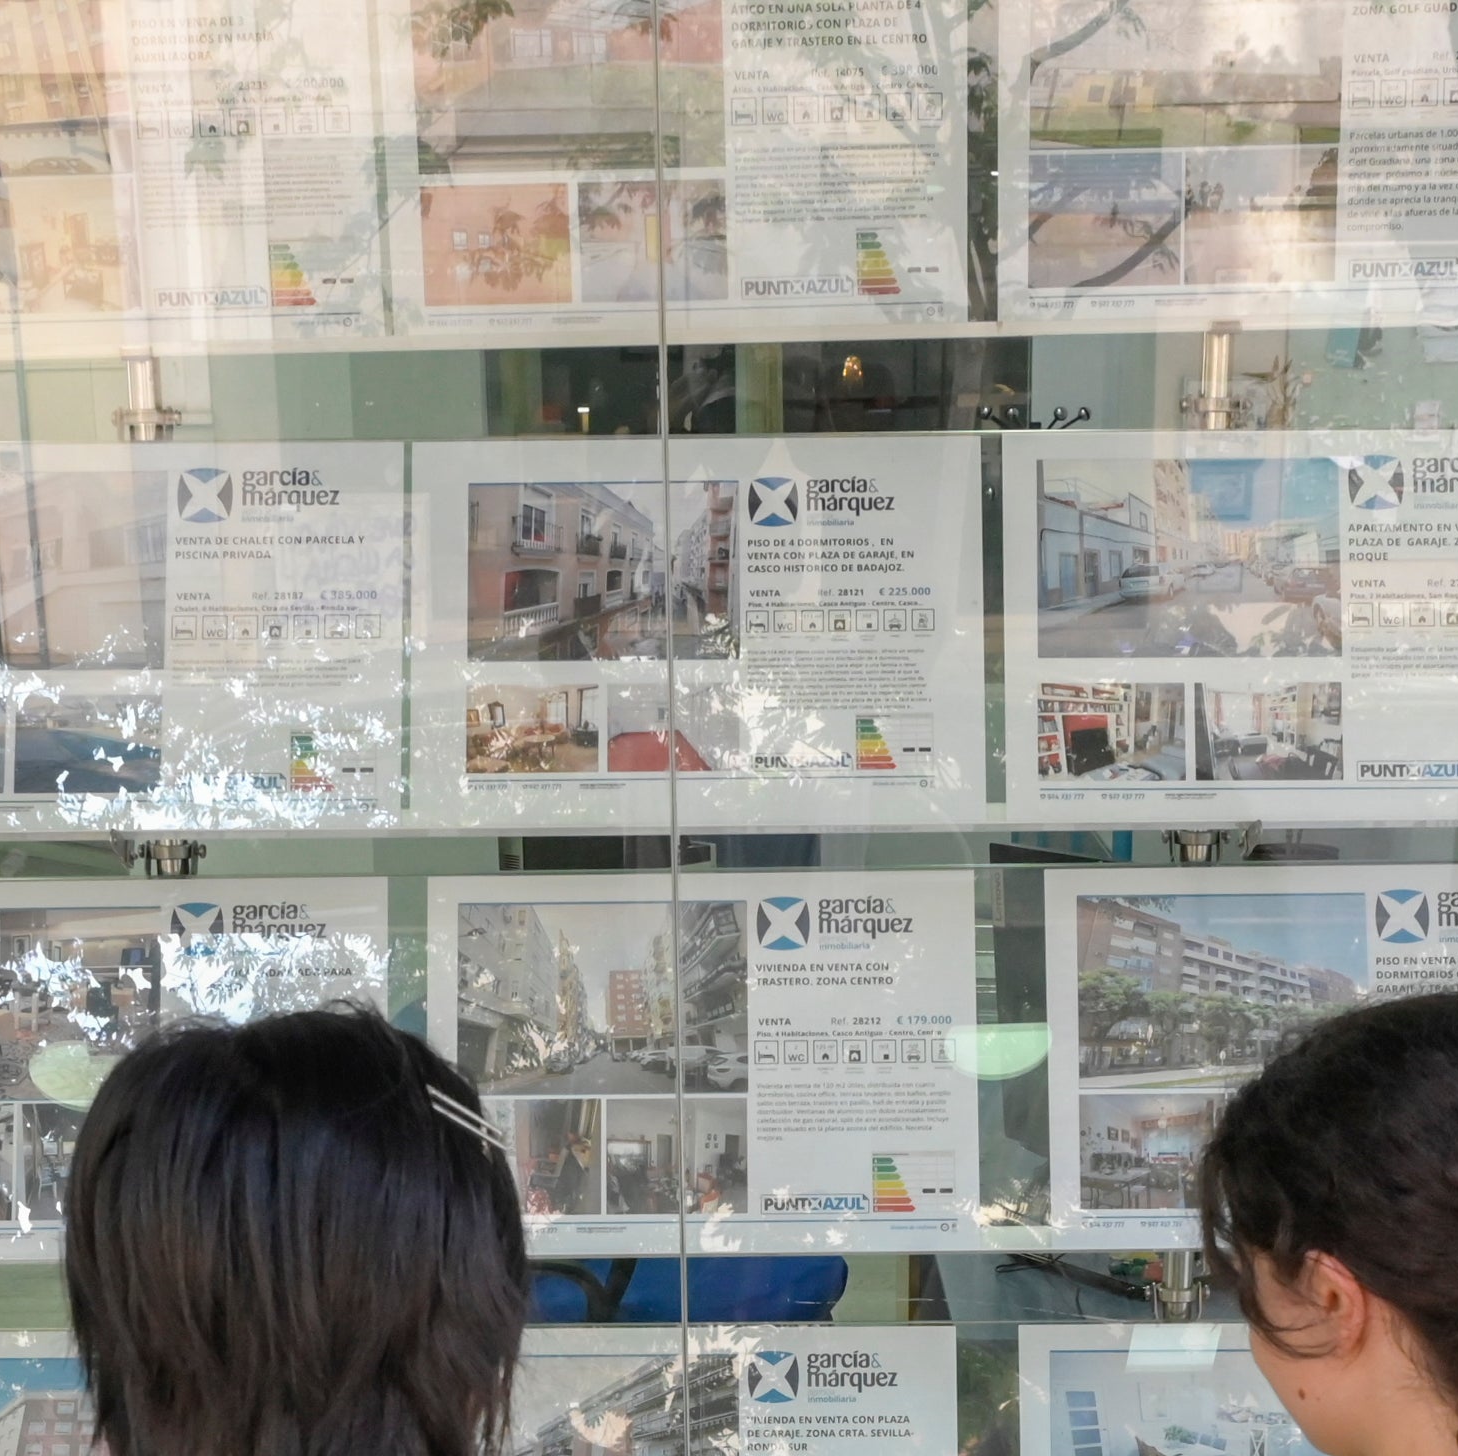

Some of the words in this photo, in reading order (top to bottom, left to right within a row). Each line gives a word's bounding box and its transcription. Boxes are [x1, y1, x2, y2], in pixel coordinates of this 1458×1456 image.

[1351, 5, 1384, 16] ZONA
[1389, 4, 1422, 15] GOLF
[787, 37, 843, 46] TRASTERO
[848, 36, 861, 45] EN
[866, 35, 877, 44] EL
[882, 34, 927, 44] CENTRO
[1354, 53, 1390, 63] VENTA
[806, 495, 895, 517] márquez
[747, 538, 771, 548] PISO
[773, 538, 786, 548] DE
[788, 538, 795, 547] 4
[797, 538, 870, 547] DORMITORIOS
[880, 537, 894, 546] EN
[175, 551, 219, 559] PISCINA
[222, 550, 271, 559] PRIVADA
[747, 551, 781, 561] VENTA
[783, 551, 805, 560] CON
[808, 550, 841, 560] PLAZA
[842, 550, 855, 560] DE
[858, 550, 898, 561] GARAJE,
[901, 550, 915, 559] EN
[747, 564, 781, 574] CASCO
[783, 563, 839, 573] HISTORICO
[841, 563, 854, 572] DE
[856, 563, 905, 574] BADAJOZ.
[749, 589, 781, 598] VENTA
[818, 589, 835, 597] Ref.
[837, 588, 864, 597] 28121
[879, 587, 885, 596] €
[888, 587, 931, 596] 225.000
[818, 916, 913, 939] márquez
[1376, 970, 1454, 980] DORMITORIOS
[757, 977, 813, 987] TRASTERO.
[816, 976, 847, 986] ZONA
[849, 976, 894, 986] CENTRO
[758, 1017, 792, 1026] VENTA
[852, 1016, 881, 1026] 28212
[896, 1016, 903, 1025] €
[907, 1015, 952, 1025] 179.000
[807, 1370, 898, 1394] márquez
